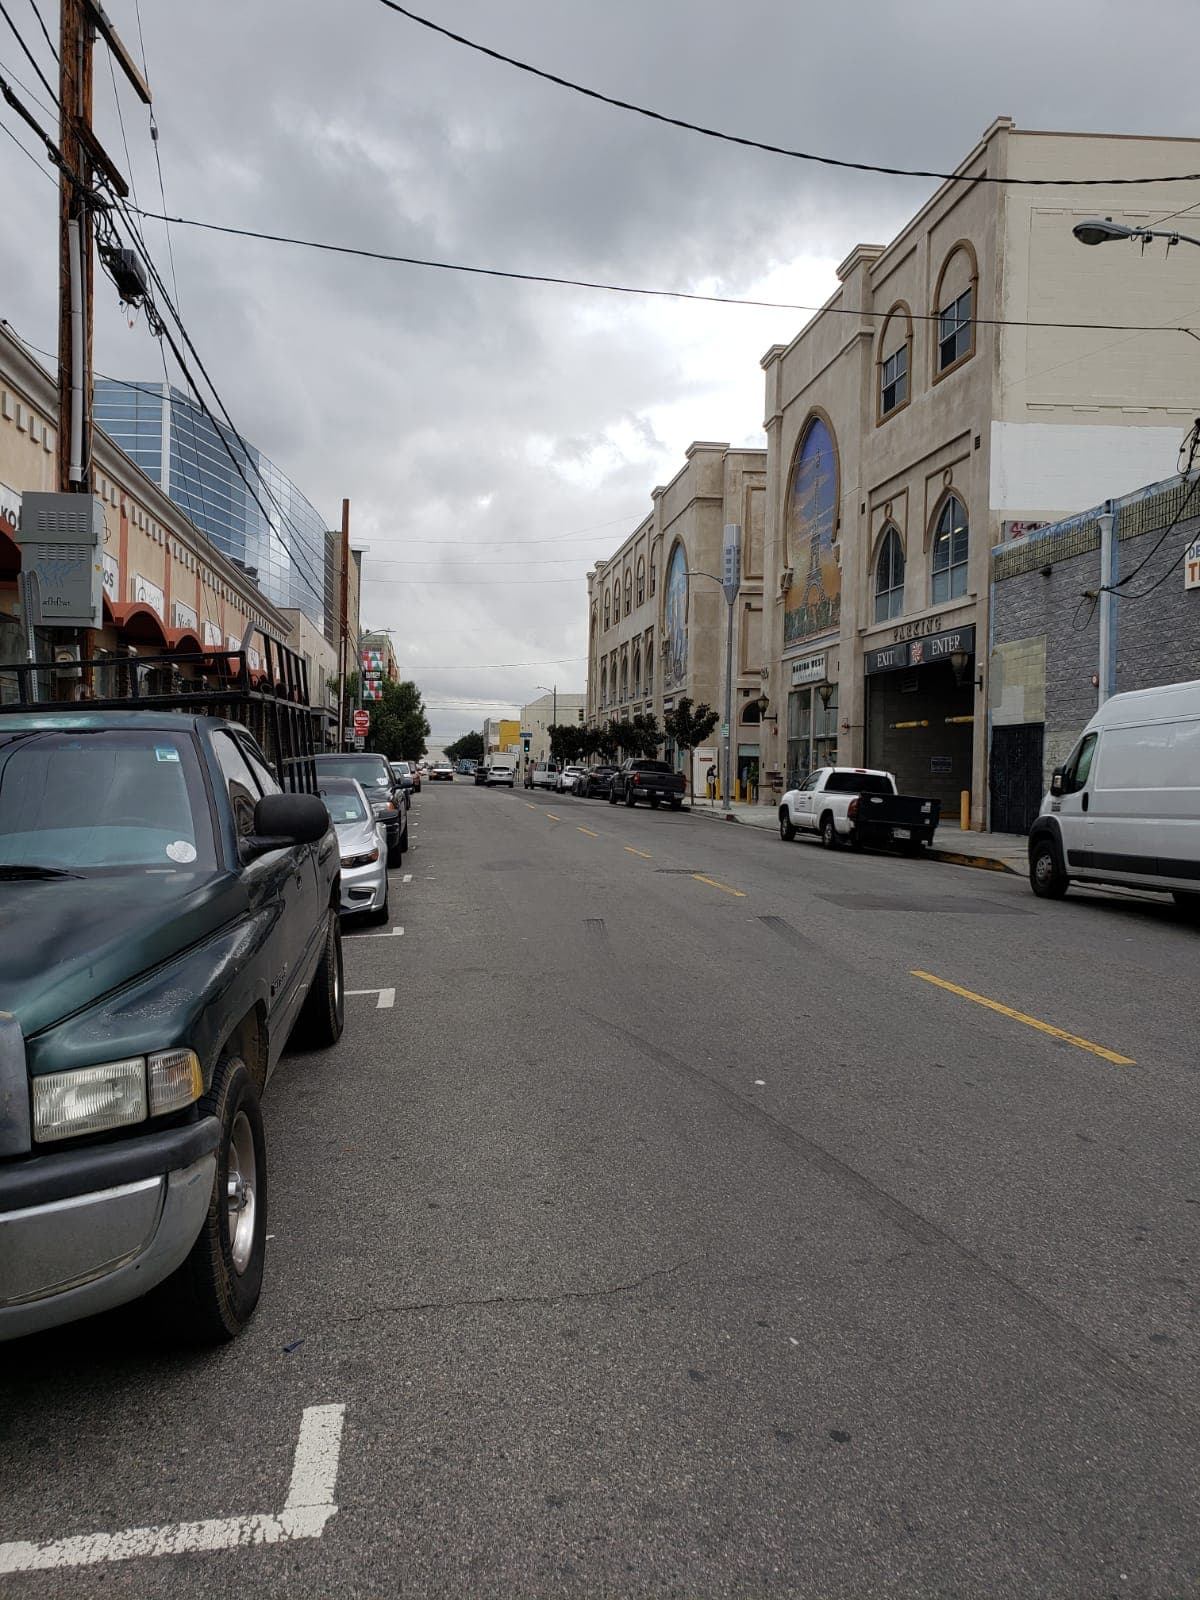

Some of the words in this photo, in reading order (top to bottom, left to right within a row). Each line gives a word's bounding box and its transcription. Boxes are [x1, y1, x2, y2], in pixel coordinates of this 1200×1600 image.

[893, 616, 943, 642] PARKING
[931, 634, 961, 656] ENTER
[877, 650, 895, 668] EXIT
